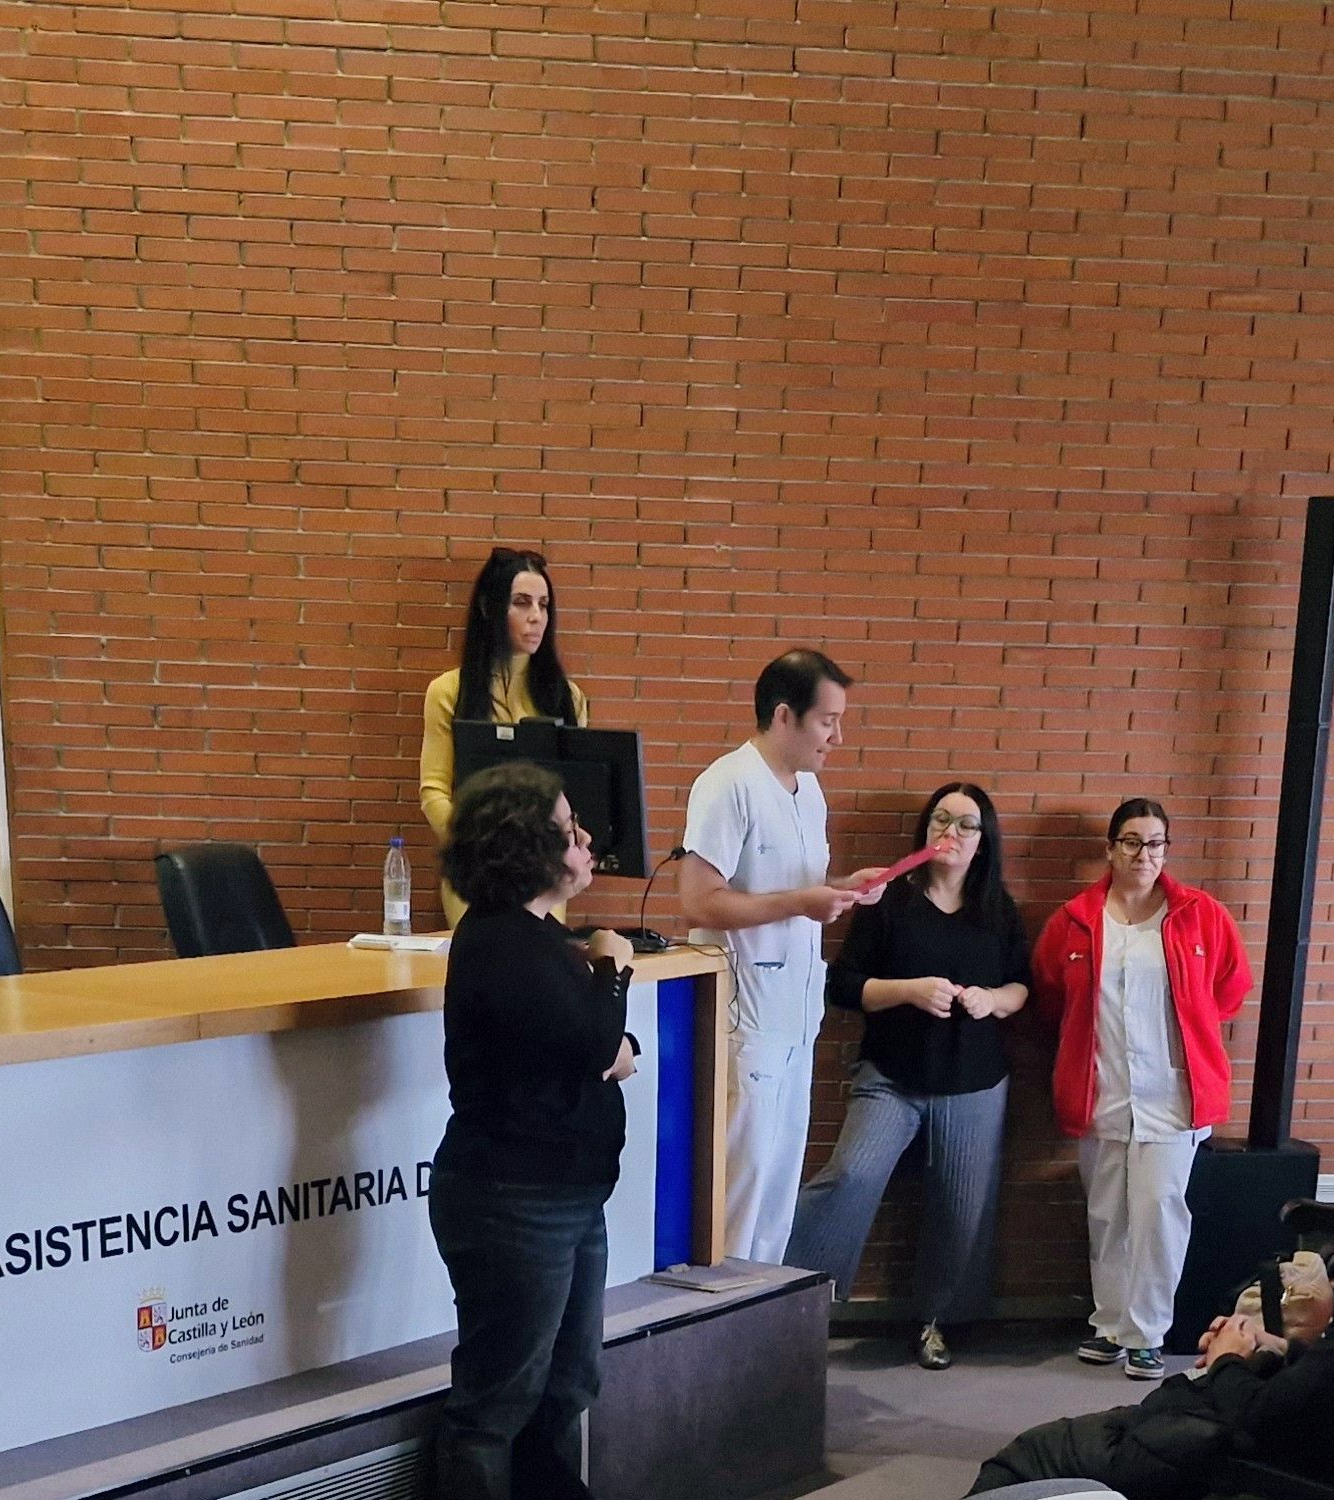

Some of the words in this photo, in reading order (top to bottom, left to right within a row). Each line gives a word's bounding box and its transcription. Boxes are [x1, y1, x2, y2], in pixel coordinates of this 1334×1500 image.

[227, 1166, 408, 1233] SANITARIA
[167, 1302, 208, 1322] Junta
[212, 1296, 229, 1312] de
[168, 1322, 217, 1344] Castilla
[220, 1321, 228, 1338] y
[232, 1311, 265, 1331] León
[218, 1343, 229, 1352] de
[231, 1334, 264, 1350] Sanidad
